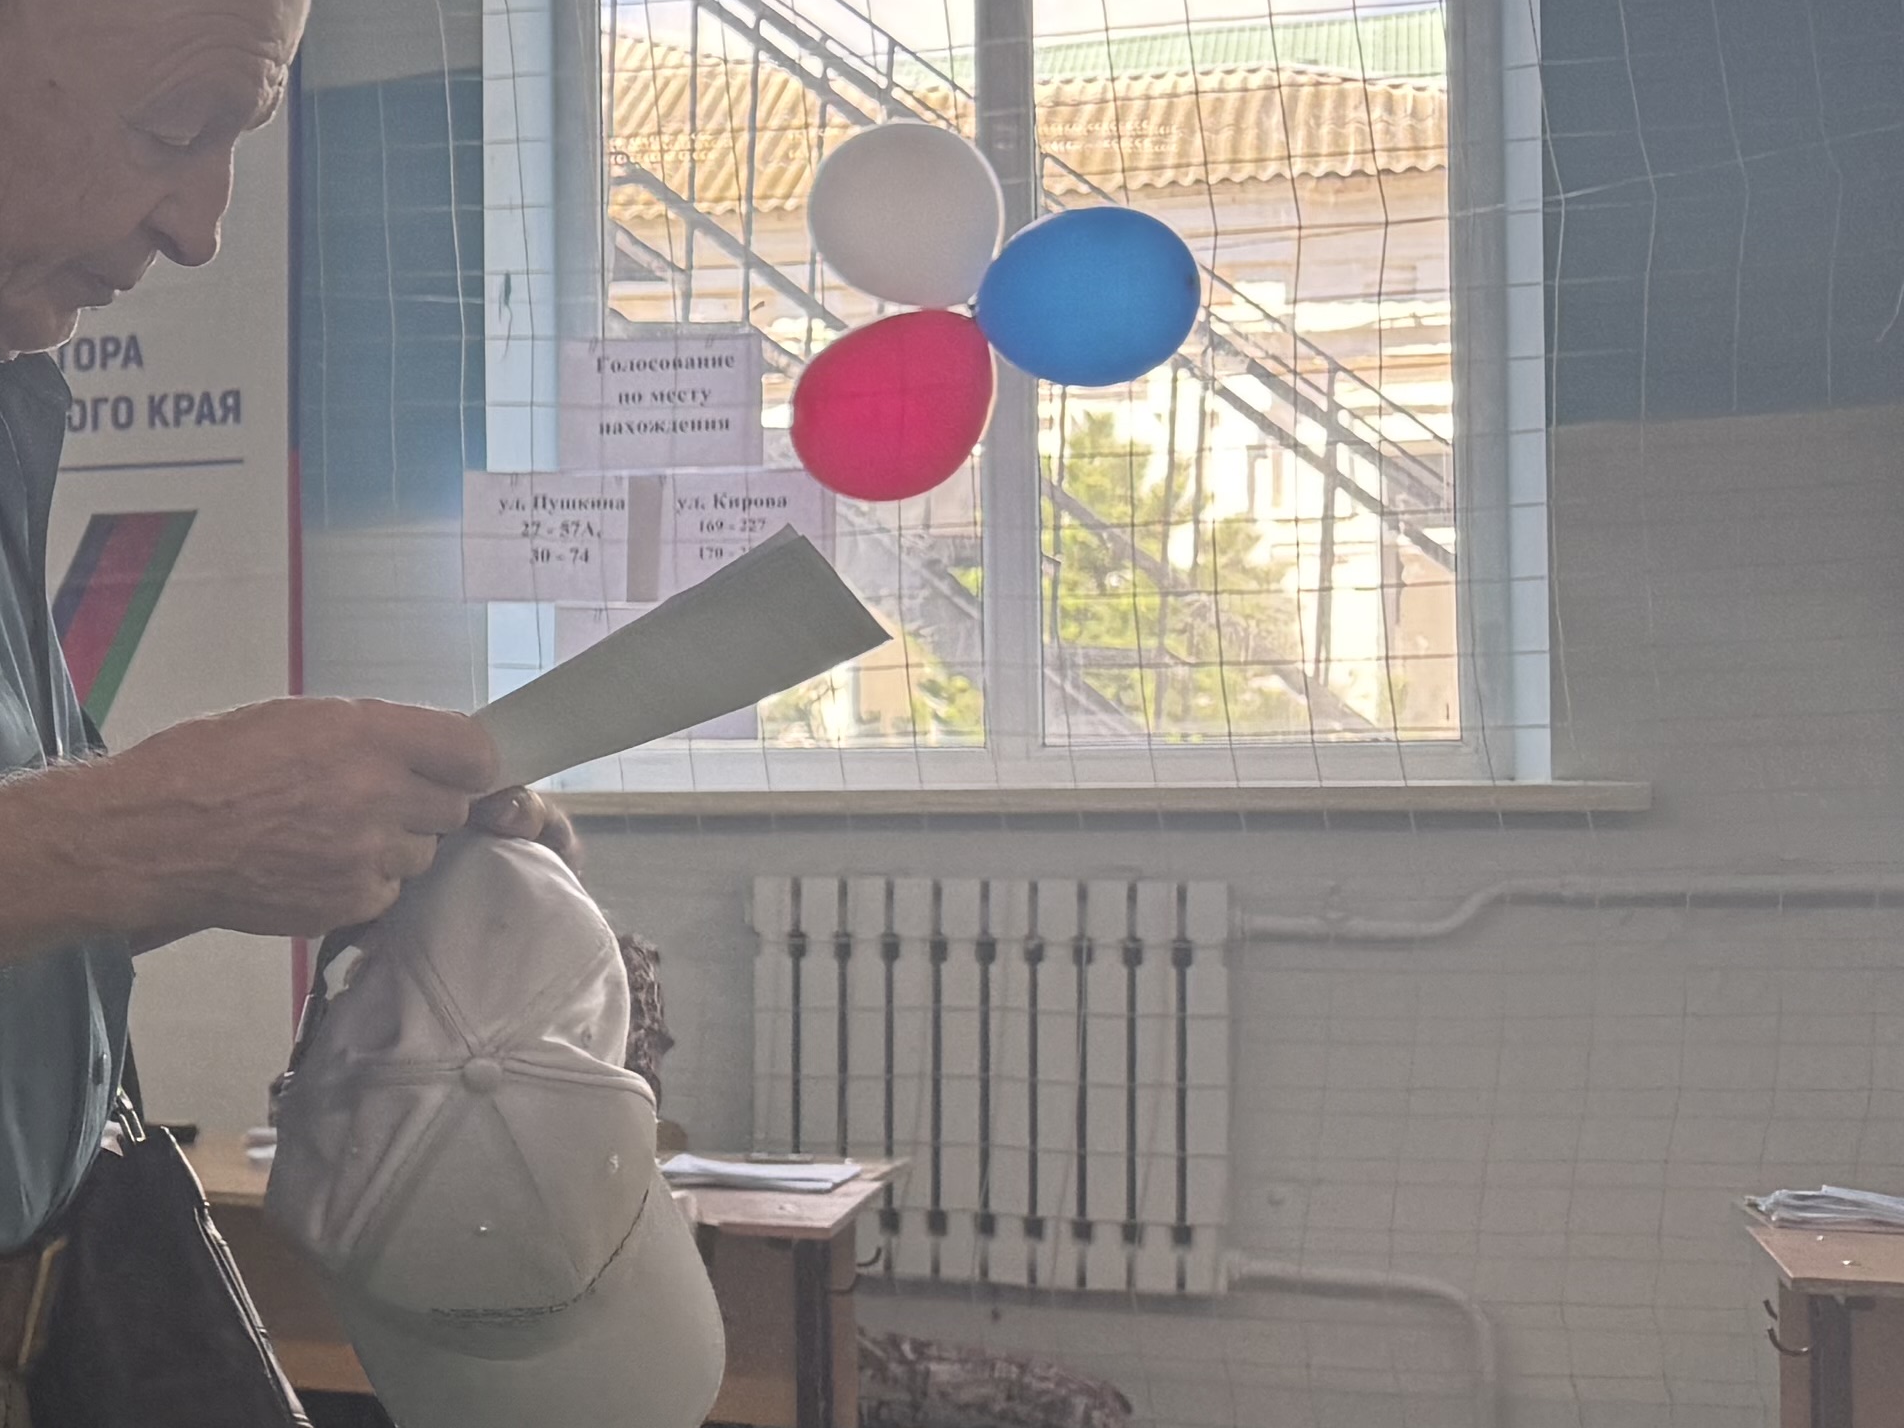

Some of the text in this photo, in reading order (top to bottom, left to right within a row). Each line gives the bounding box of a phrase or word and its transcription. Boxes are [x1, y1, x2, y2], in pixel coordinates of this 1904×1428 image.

[597, 355, 735, 373] Голосование
[618, 388, 712, 408] по месту
[147, 389, 241, 429] КРАЯ
[599, 418, 730, 436] нахождения
[499, 494, 625, 515] ул. Пушкина
[676, 493, 788, 515] ул. Кирова
